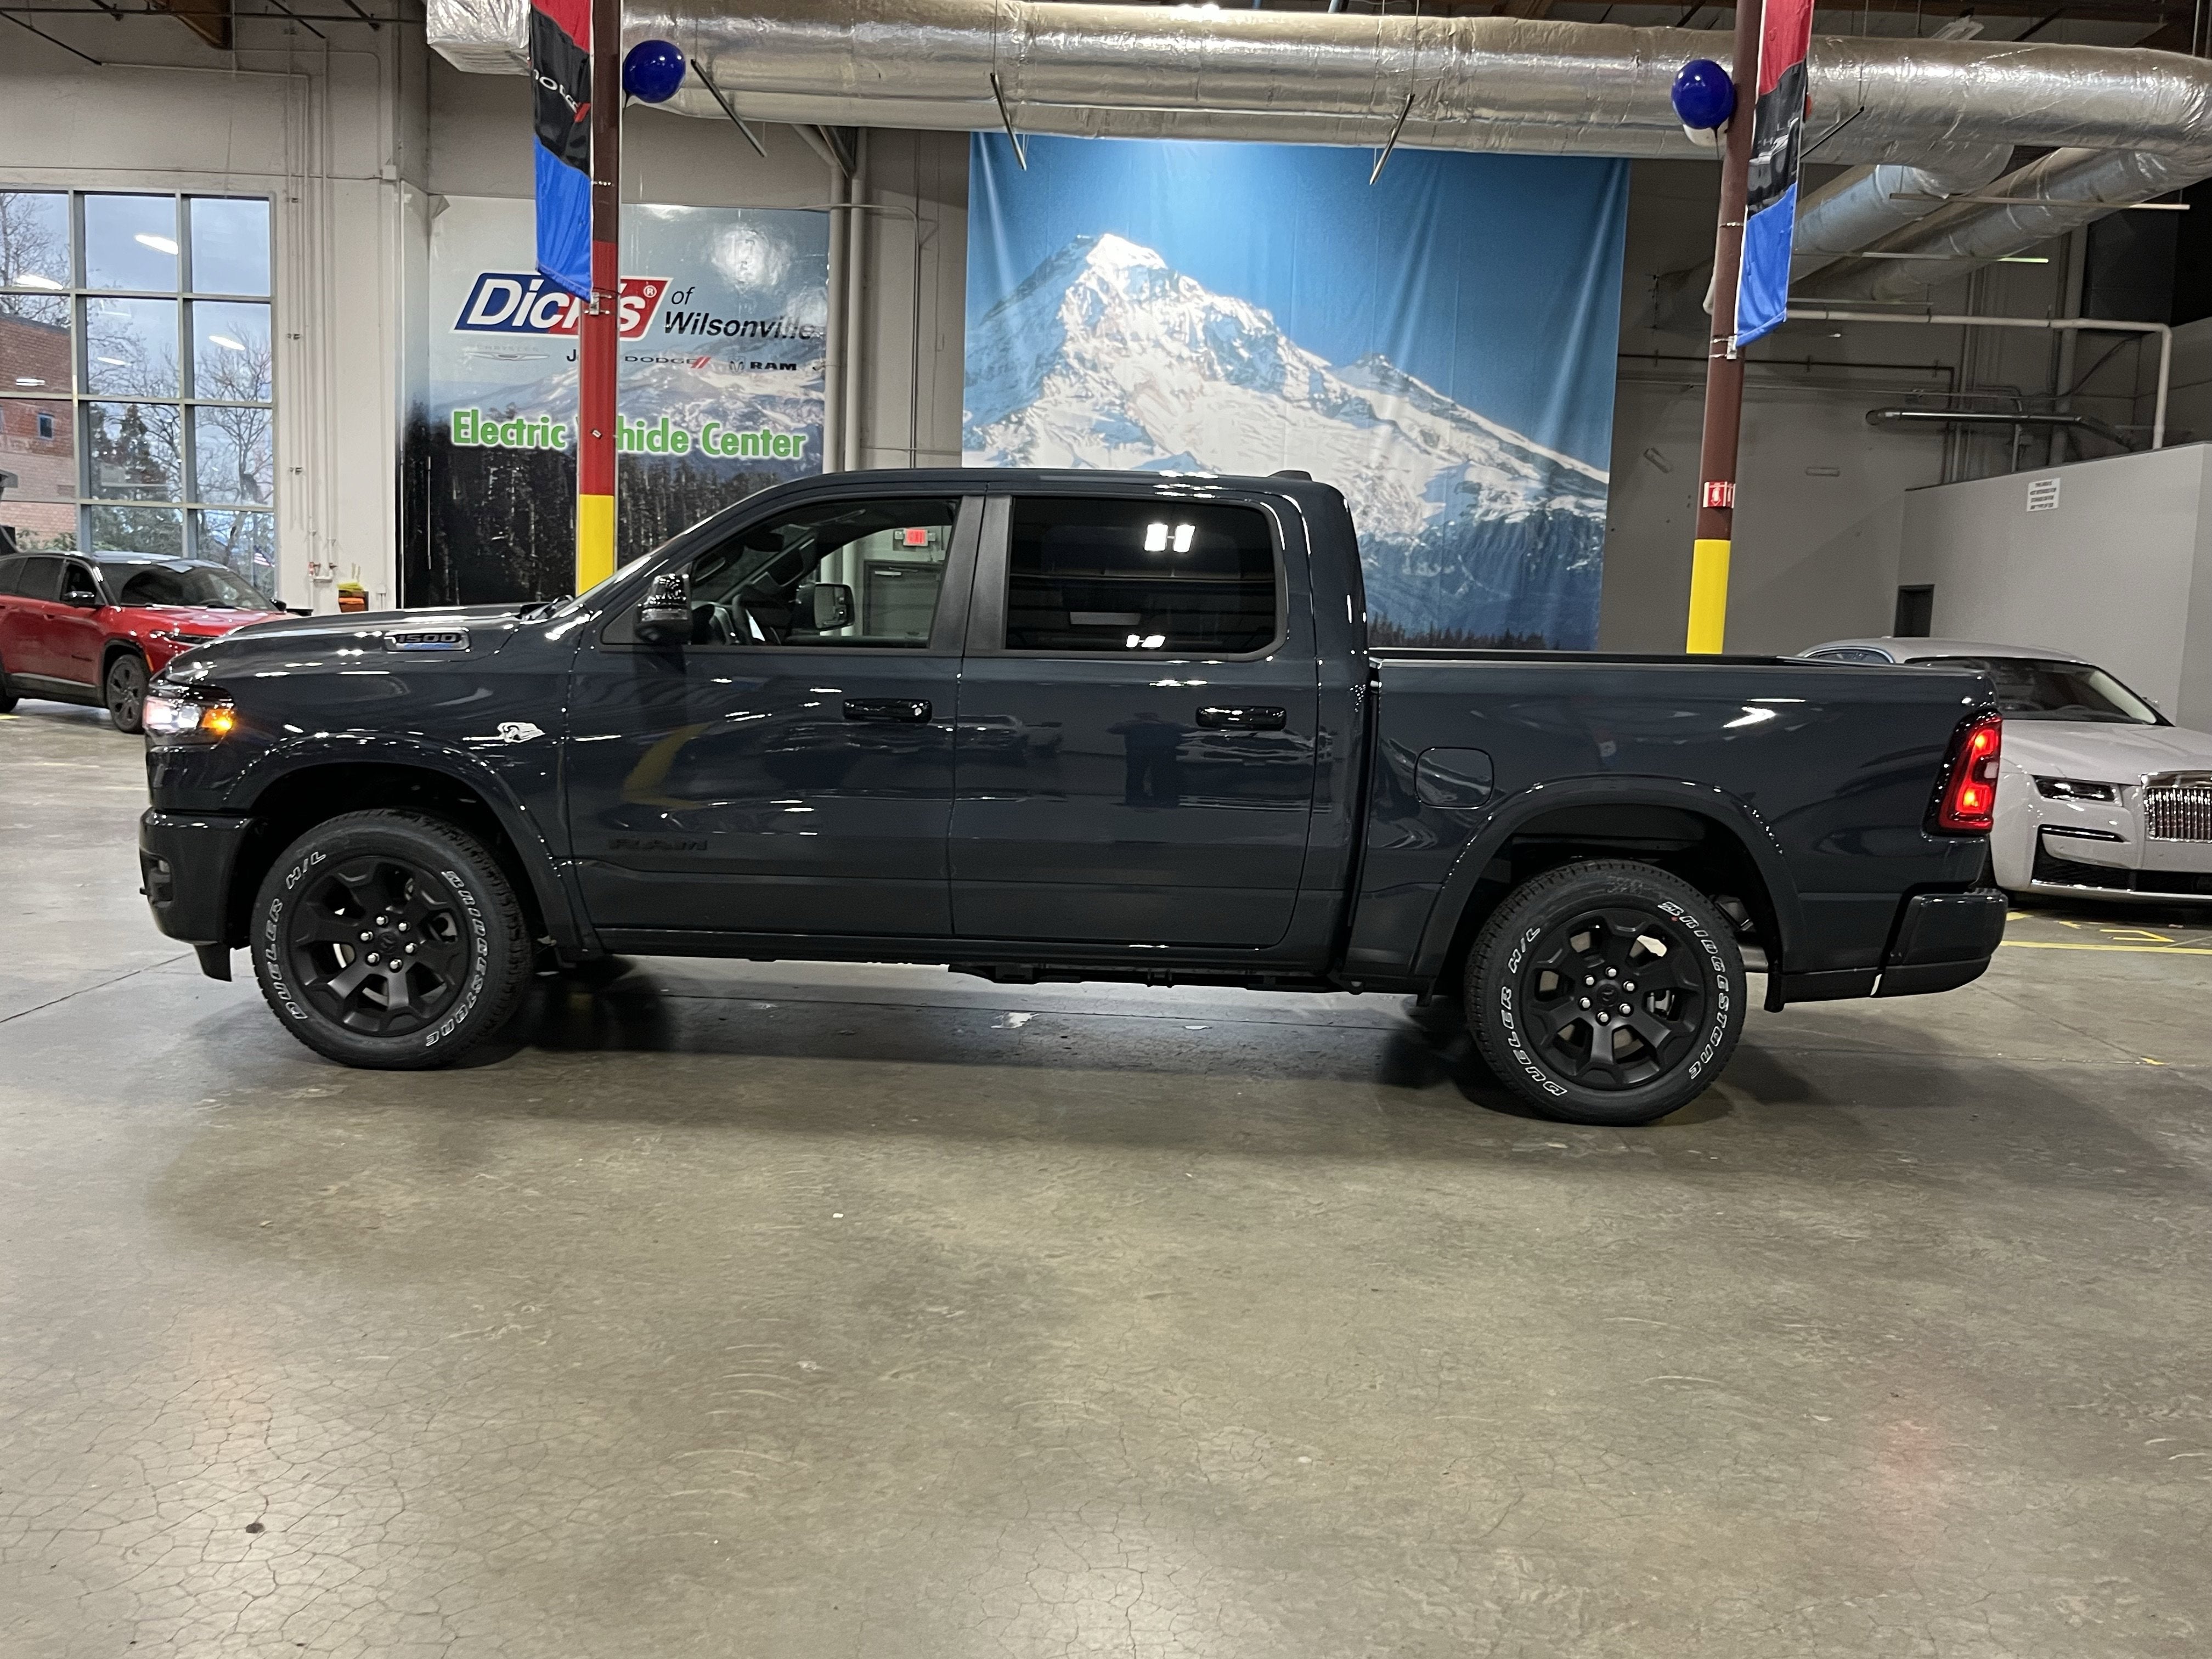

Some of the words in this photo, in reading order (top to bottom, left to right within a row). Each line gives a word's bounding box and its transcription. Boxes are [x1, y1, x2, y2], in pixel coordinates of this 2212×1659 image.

[671, 286, 696, 305] of
[750, 361, 797, 371] RAM
[453, 409, 566, 448] Electric
[702, 422, 806, 458] Center
[398, 634, 456, 642] 1500
[265, 898, 308, 1020] DUELER
[425, 870, 488, 1047] BRIDGESTONE
[1657, 901, 1730, 1080] BRIDGESTONE
[1500, 986, 1568, 1097] DUELER
